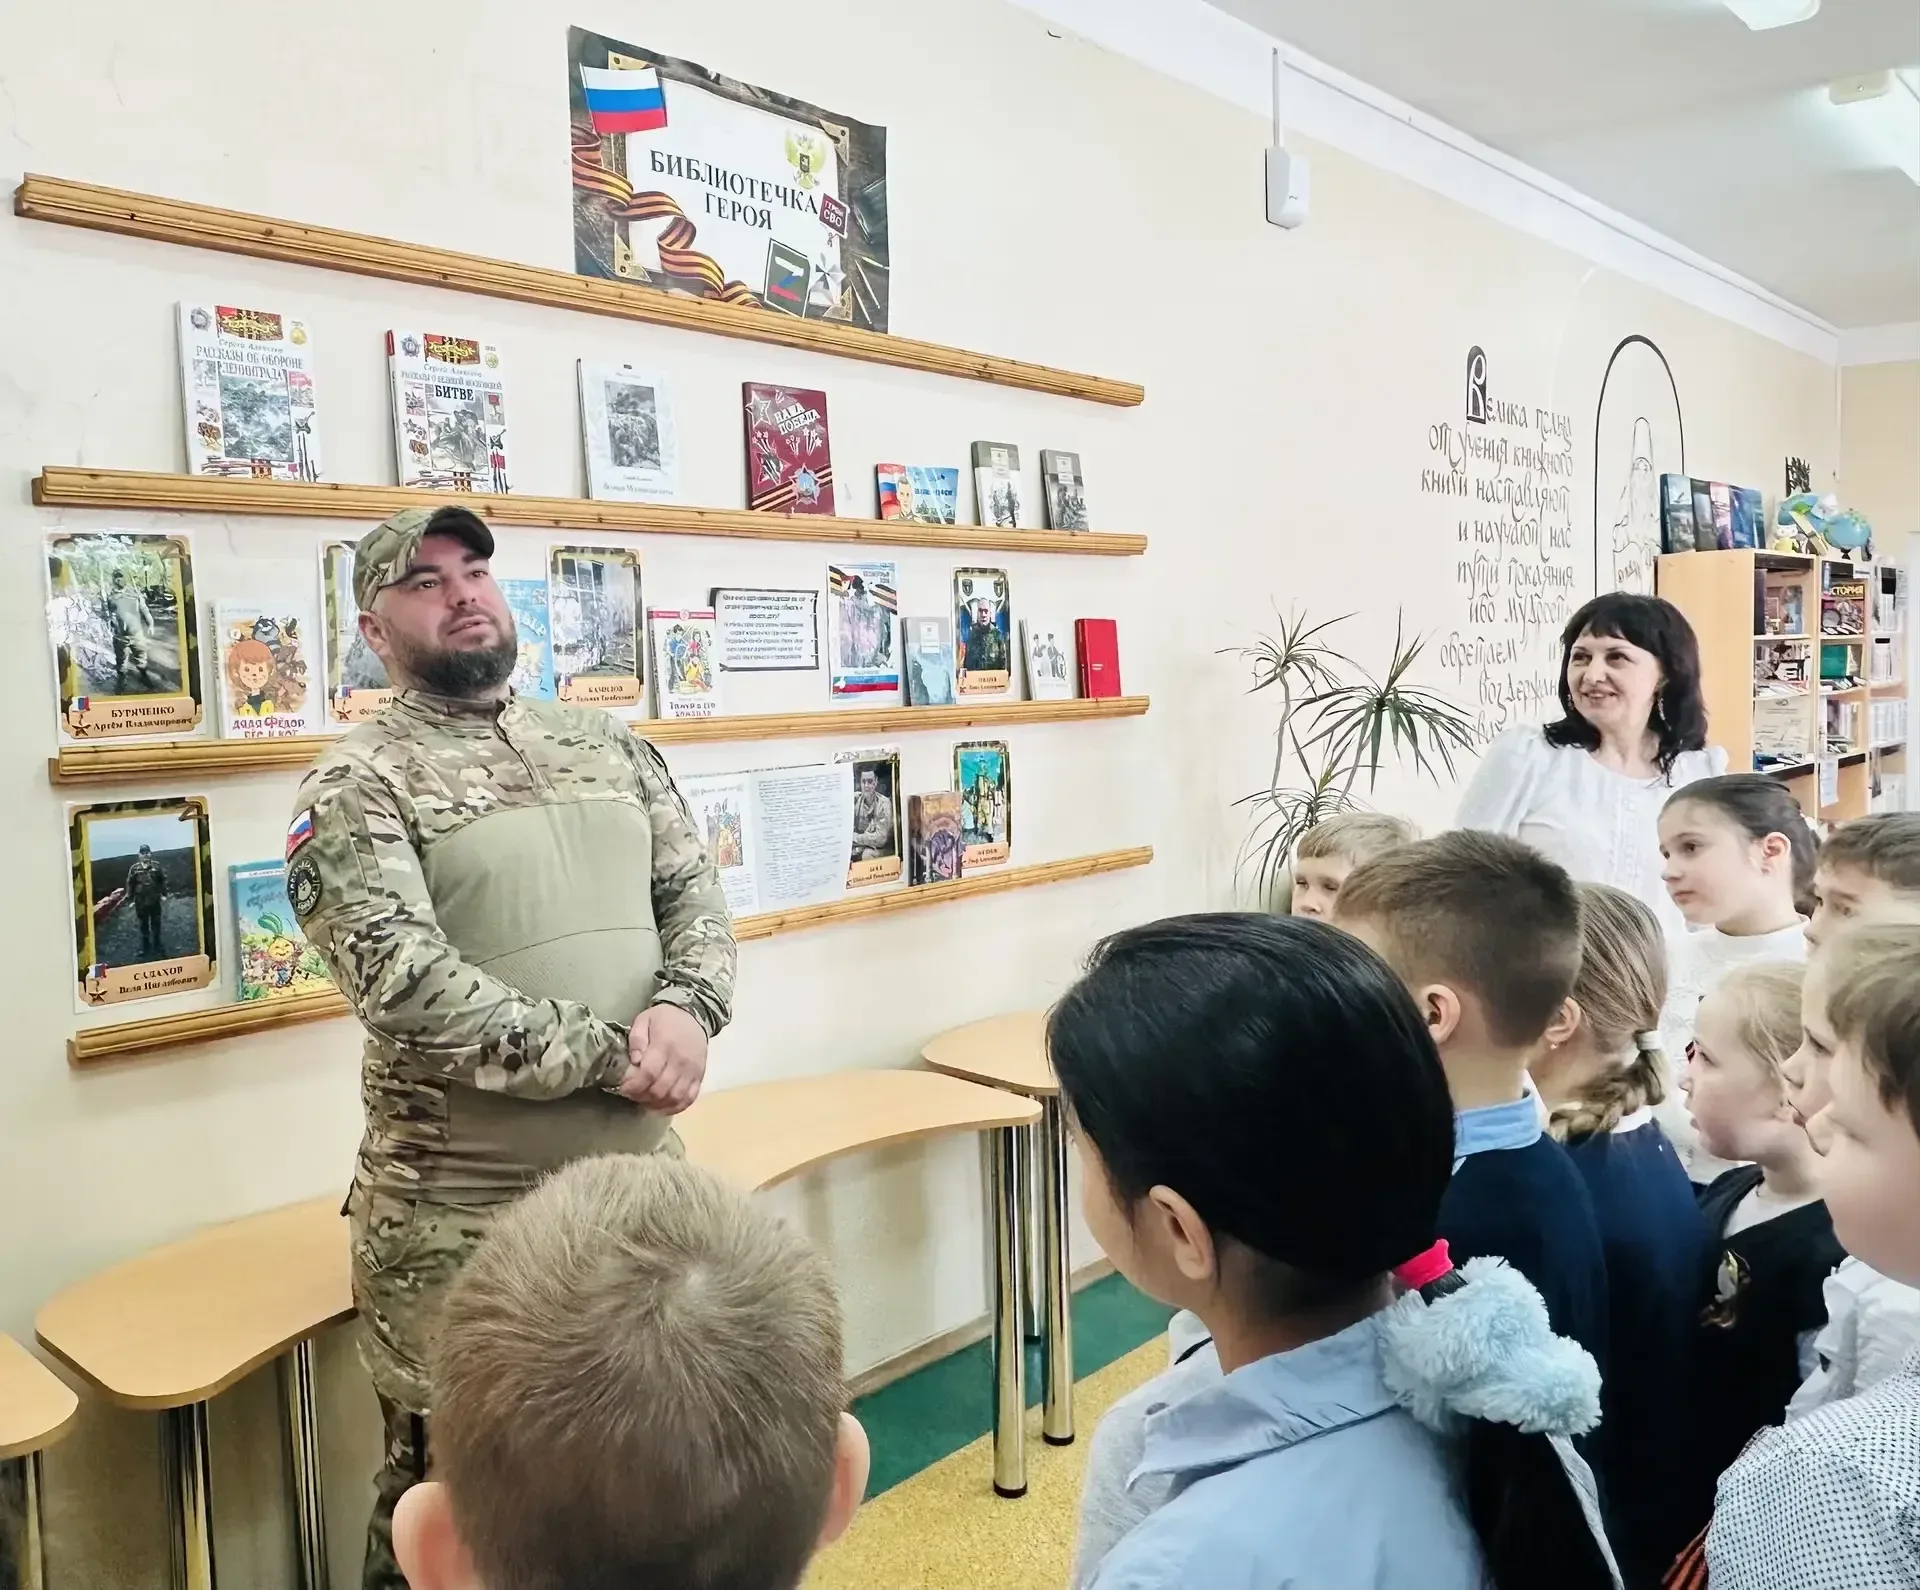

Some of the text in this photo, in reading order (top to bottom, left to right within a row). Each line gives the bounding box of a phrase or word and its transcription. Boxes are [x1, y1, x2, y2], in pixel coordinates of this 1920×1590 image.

[650, 149, 819, 215] БИБЛИОТЕЧКА
[704, 192, 773, 230] ГЕРОЯ
[823, 208, 842, 227] СВО
[196, 345, 304, 369] РАССКАЗЫ ОБ ОБОРОНЕ
[434, 384, 475, 402] БИТВЕ
[1421, 467, 1469, 497] книги
[1458, 514, 1572, 563] и научают нас
[1479, 668, 1559, 726] воздержан
[232, 718, 263, 730] ДЯДЯ
